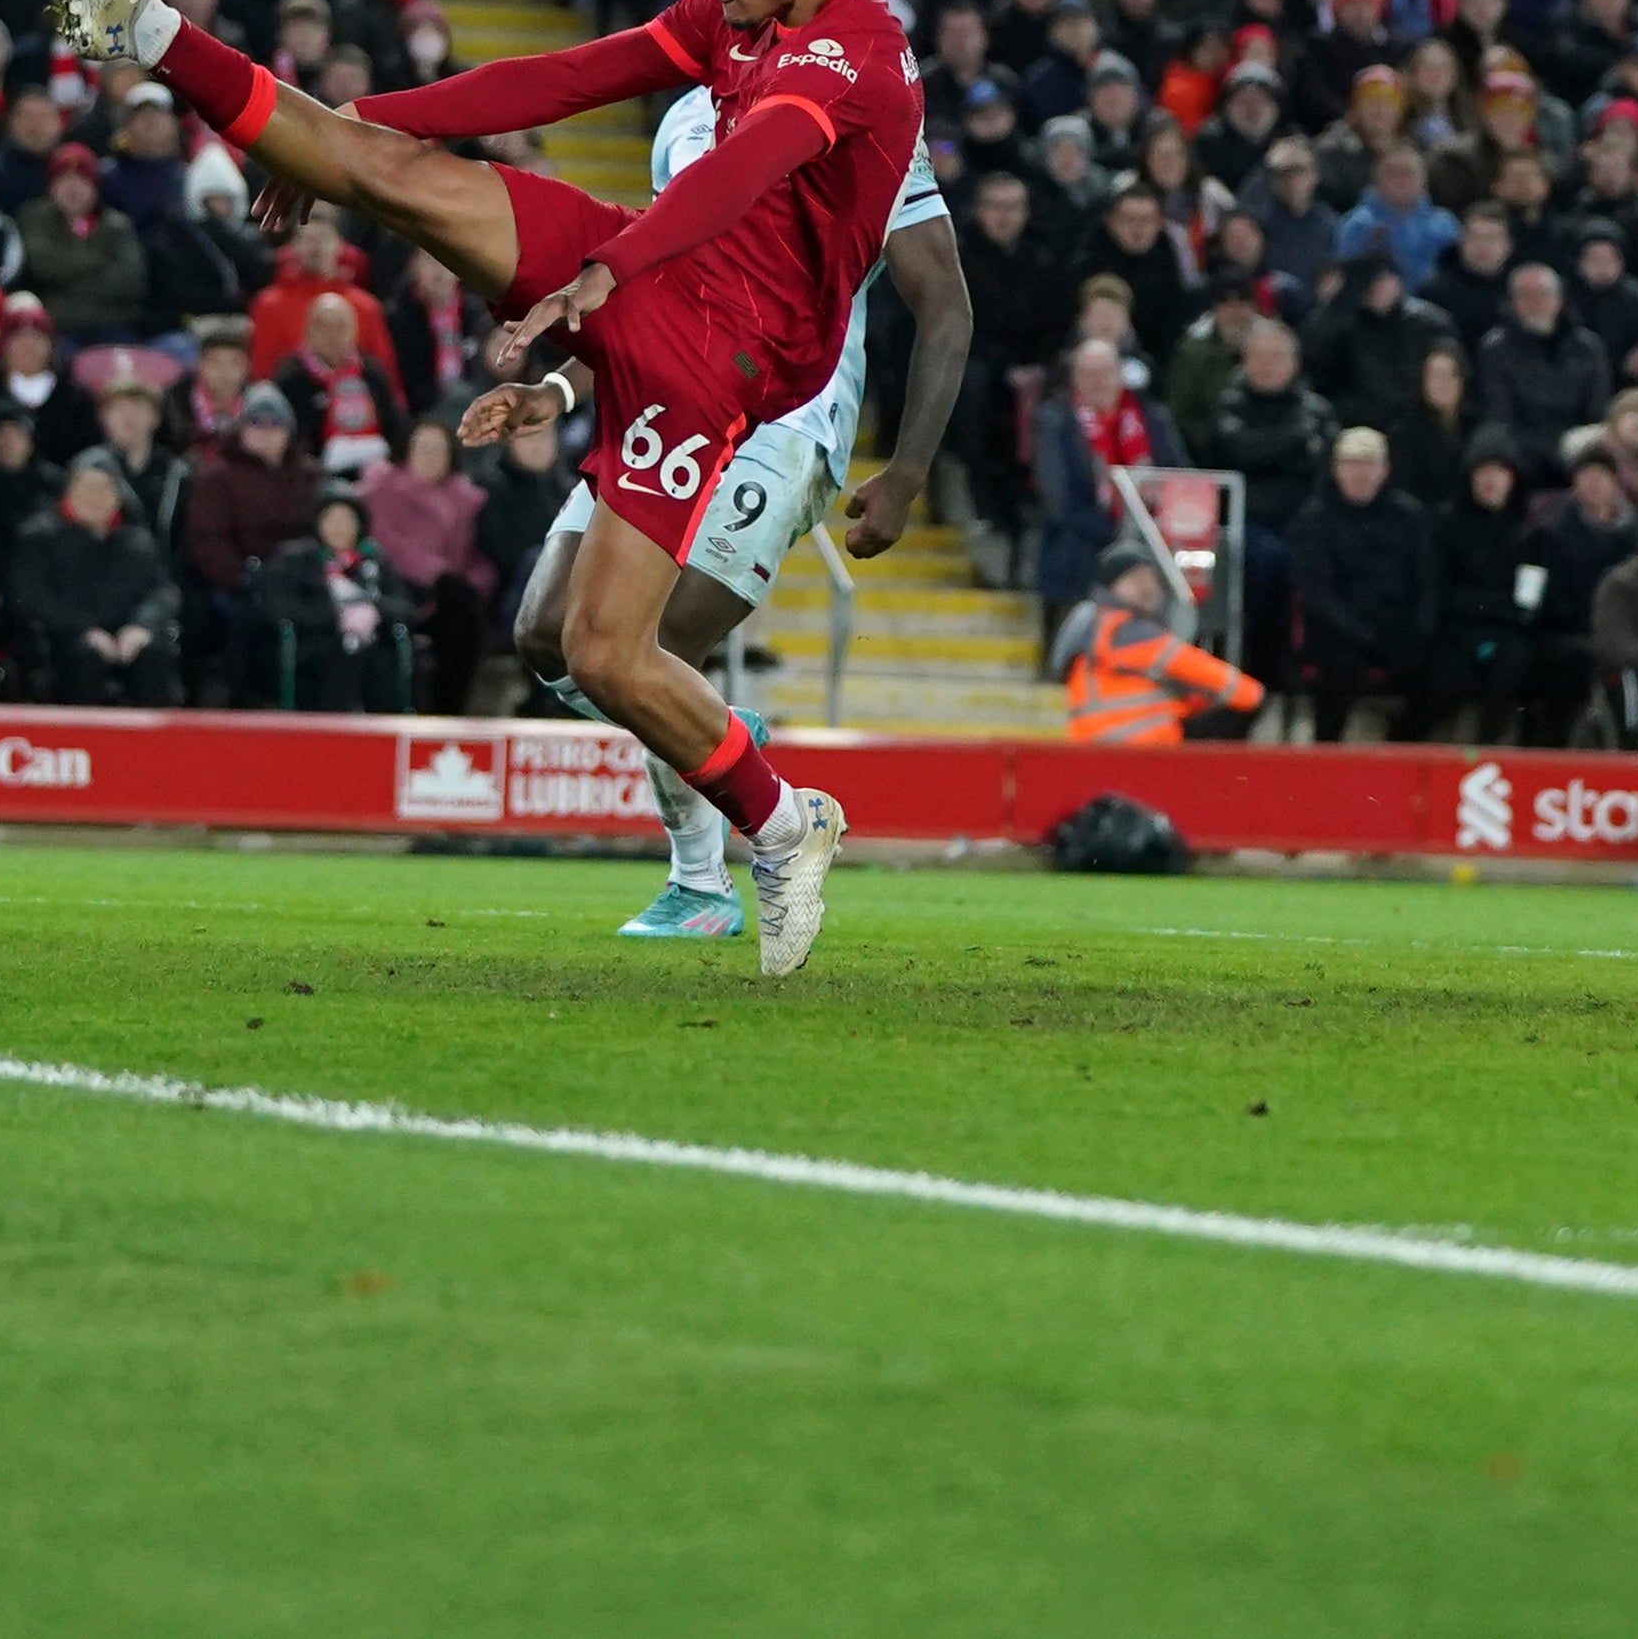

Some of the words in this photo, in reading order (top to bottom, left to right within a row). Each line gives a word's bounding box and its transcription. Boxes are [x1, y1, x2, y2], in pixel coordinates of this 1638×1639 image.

[776, 53, 859, 84] Expedia
[622, 404, 710, 500] 66
[723, 481, 767, 532] 9
